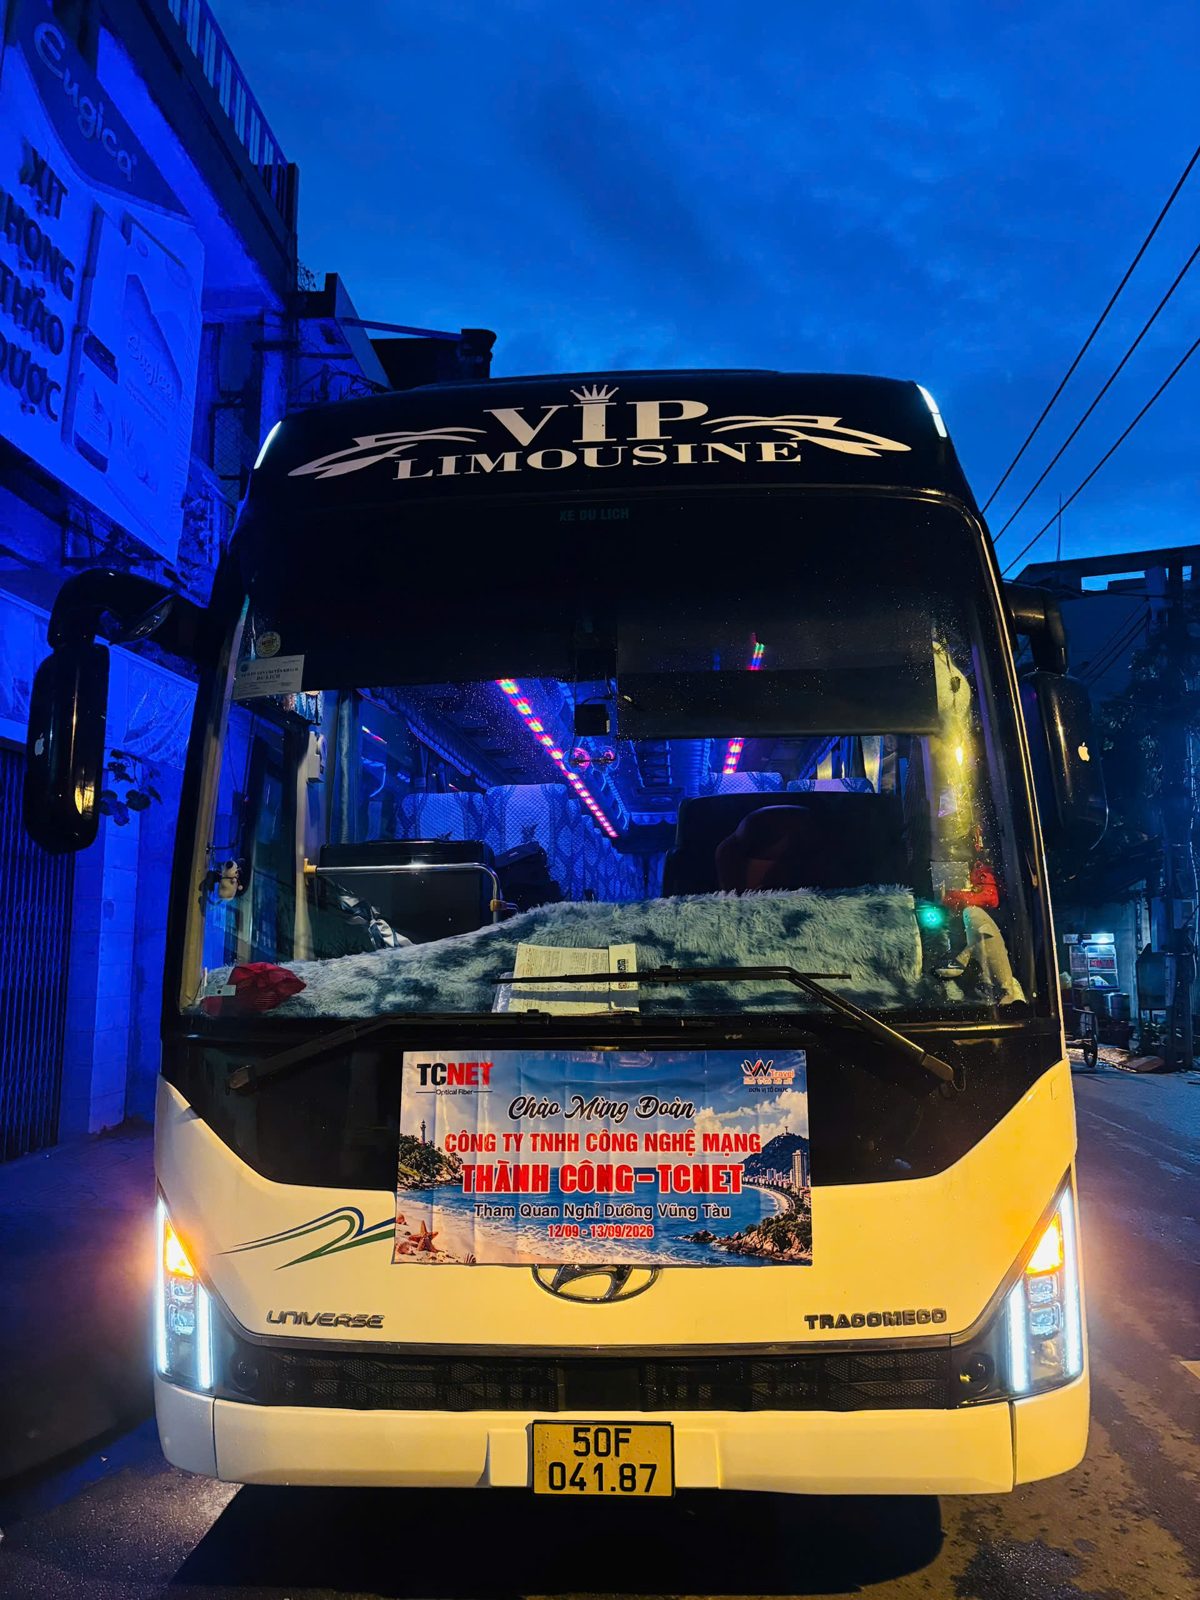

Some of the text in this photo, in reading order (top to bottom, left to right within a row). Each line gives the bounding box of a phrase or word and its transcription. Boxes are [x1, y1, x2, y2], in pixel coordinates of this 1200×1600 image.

[483, 400, 709, 447] VIP
[393, 441, 801, 480] LIMOUSINE
[416, 1062, 494, 1086] TCNET
[508, 1095, 697, 1124] Chào Mừng Đoàn
[445, 1128, 763, 1158] CÔNG TY TNHH CÔNG NGHỆ MẠNG
[461, 1159, 550, 1194] THÀNH
[474, 1201, 731, 1220] Tham Quan Nghỉ Dưỡng Vũng Tàu
[548, 1224, 579, 1239] 12/09
[590, 1223, 655, 1240] 13/09/2026
[265, 1309, 385, 1329] UNIVERSE
[573, 1427, 632, 1457] 50F
[548, 1461, 657, 1493] 041.87
